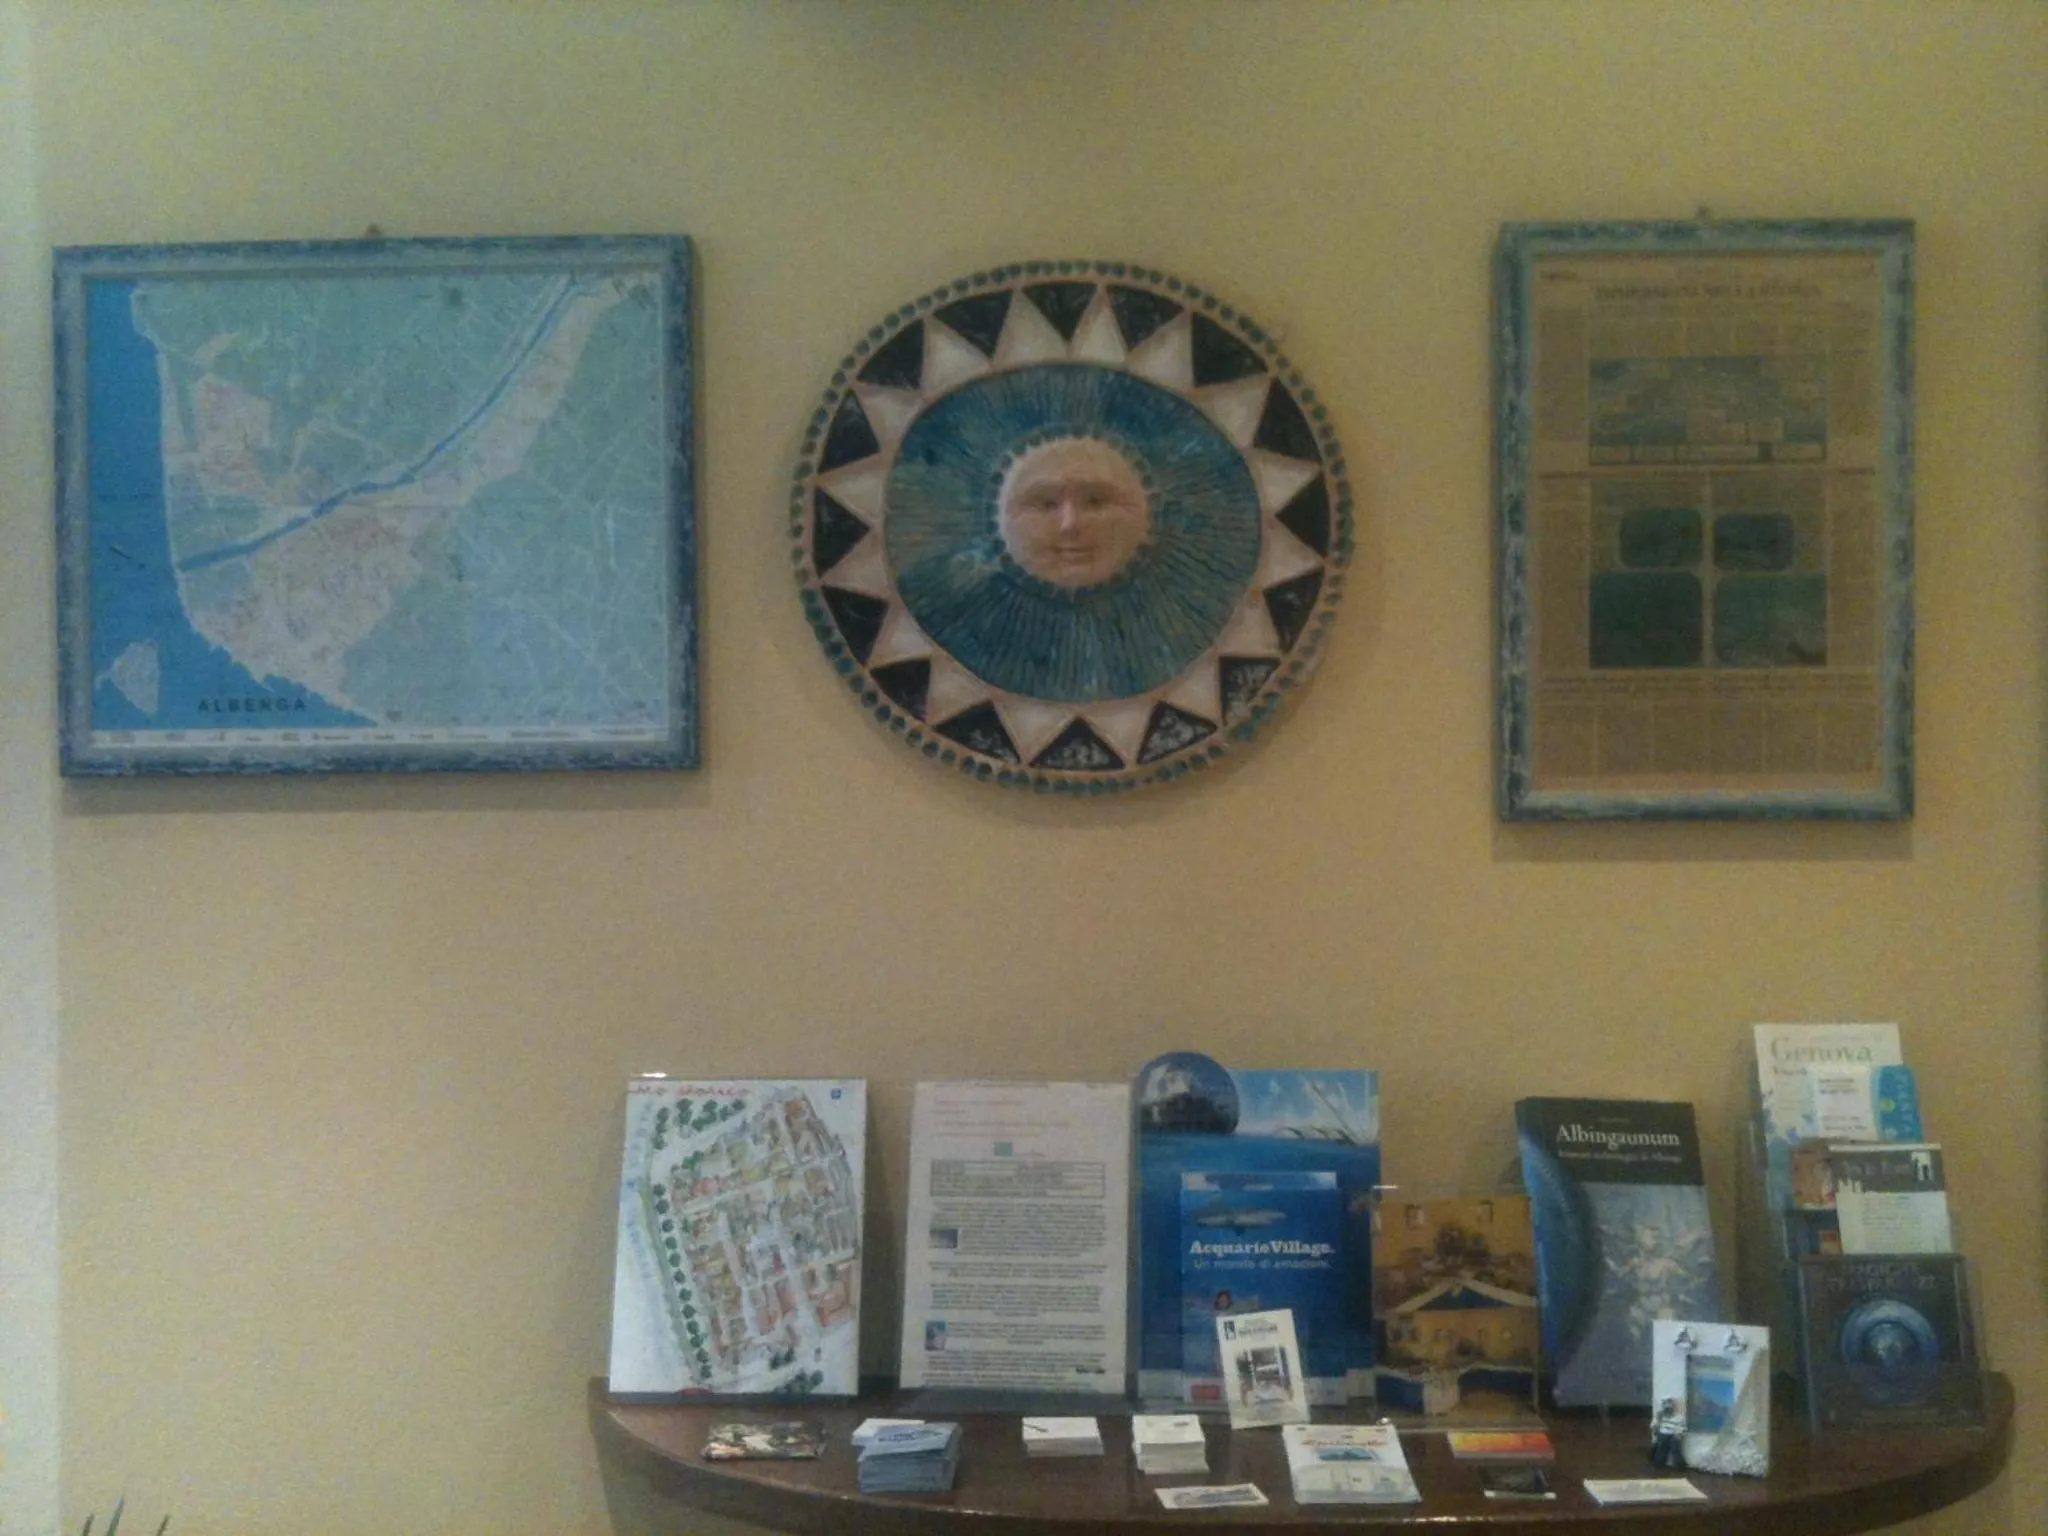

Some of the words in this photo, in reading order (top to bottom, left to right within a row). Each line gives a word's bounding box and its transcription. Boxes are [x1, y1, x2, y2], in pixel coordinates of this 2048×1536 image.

[198, 697, 306, 713] ALBENGA
[1770, 1036, 1874, 1062] Genova
[1557, 1123, 1680, 1151] Albingaunum
